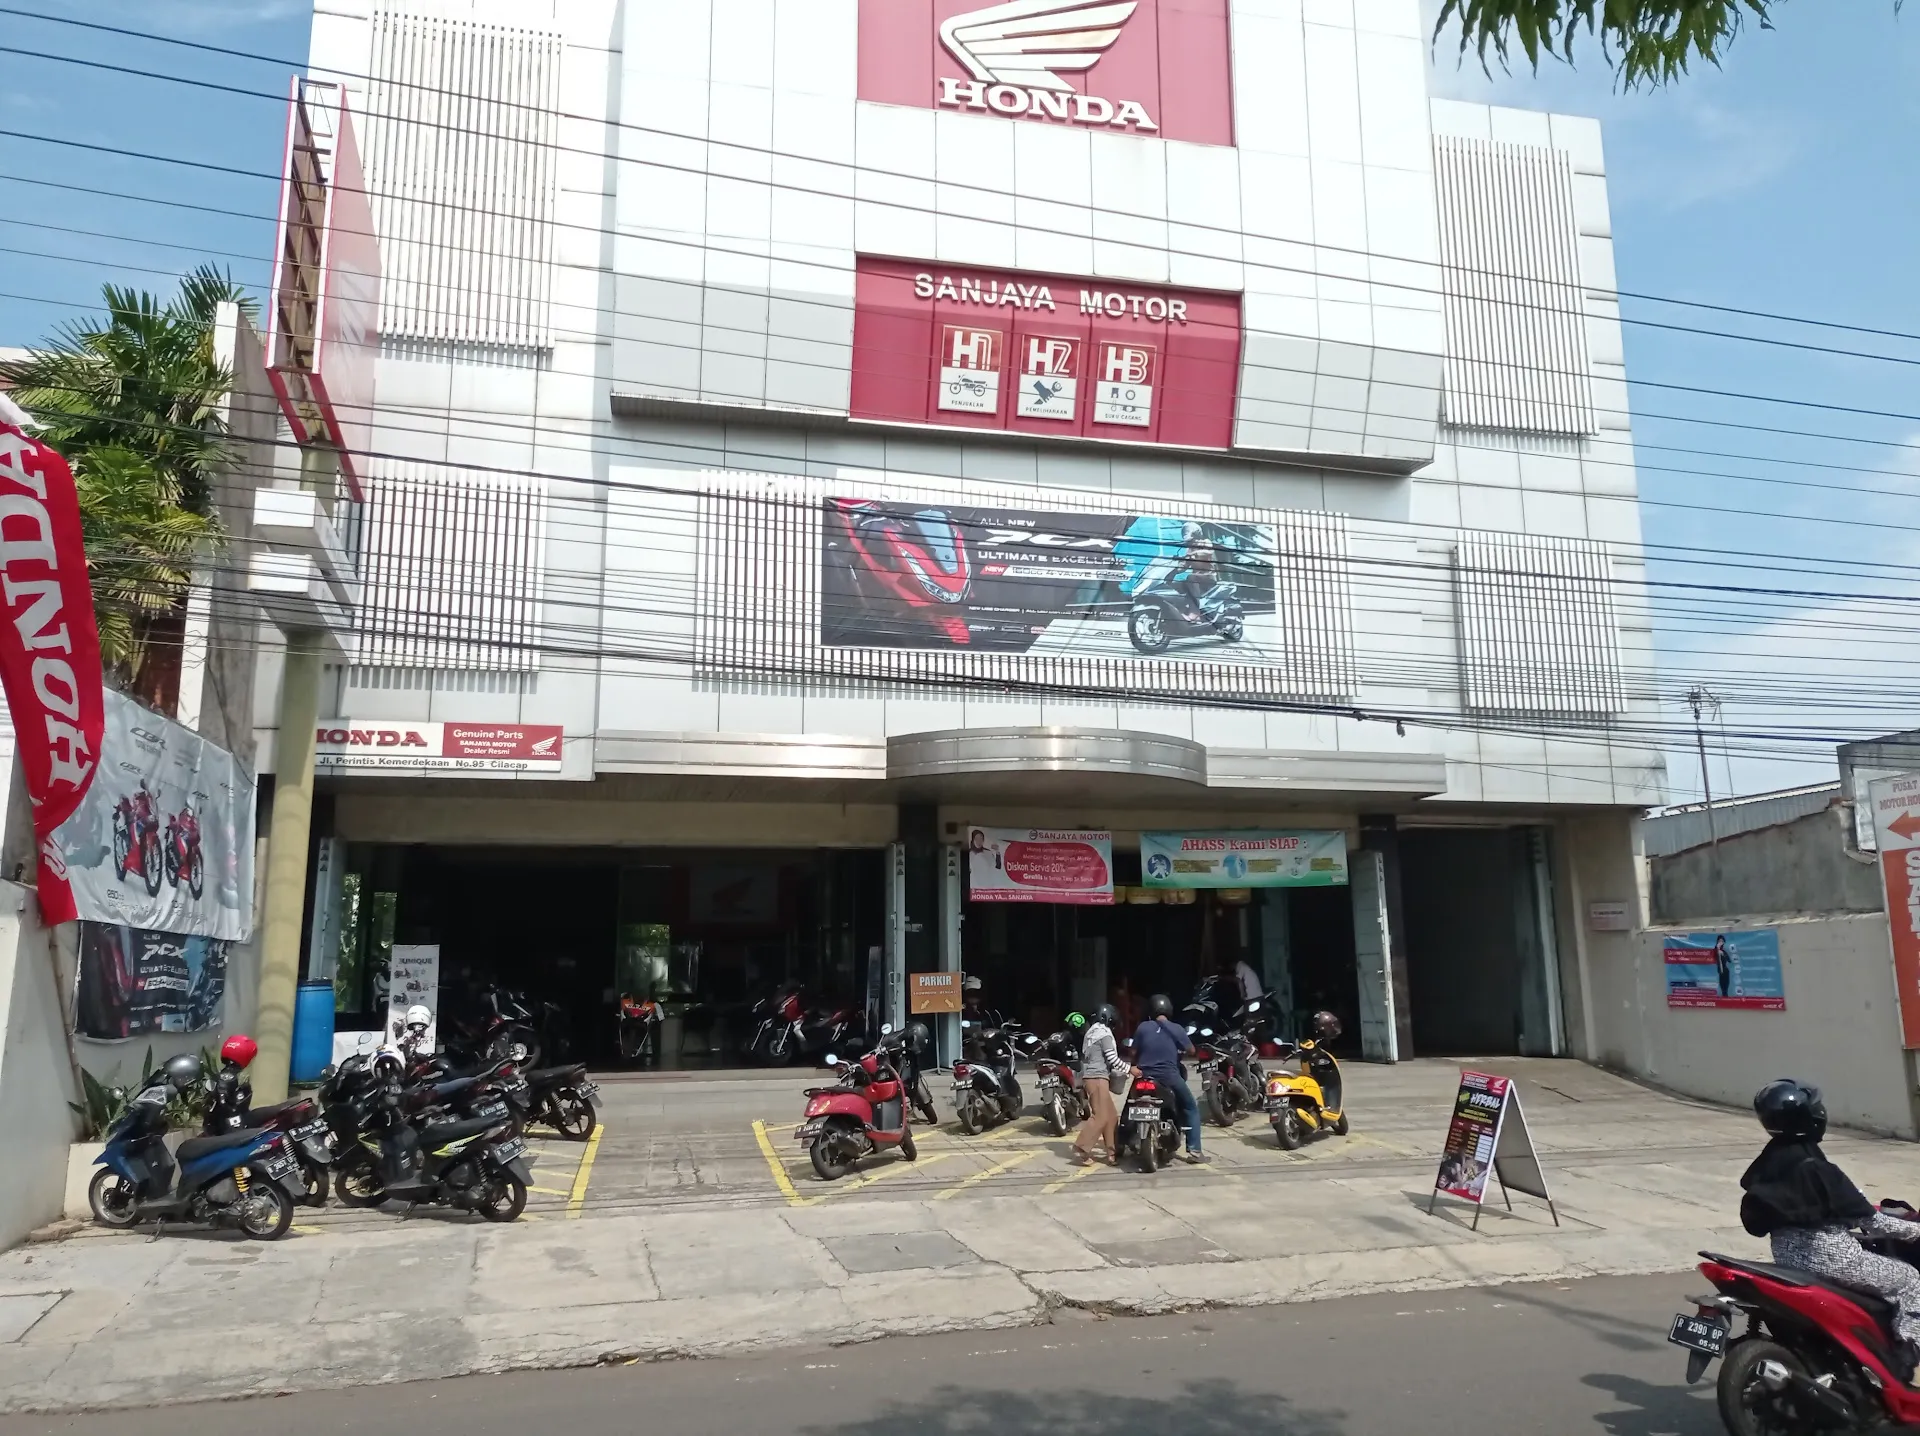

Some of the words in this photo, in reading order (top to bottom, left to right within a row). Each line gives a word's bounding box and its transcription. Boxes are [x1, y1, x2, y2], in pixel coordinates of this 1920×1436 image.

[939, 77, 1159, 131] HONDA
[915, 274, 1056, 311] SANJAYA
[1080, 290, 1187, 324] MOTOR
[952, 330, 992, 370] H1
[1106, 346, 1148, 384] H3
[980, 518, 1004, 526] ALL
[1008, 519, 1036, 527] NEW
[978, 551, 1048, 562] ULTIMATE
[1052, 556, 1135, 565] EXCELLENCE
[453, 729, 495, 739] Genuine
[497, 730, 524, 740] Parts
[336, 757, 375, 765] Perintis
[378, 758, 450, 767] Kemerdekaan
[455, 760, 485, 768] No.95
[490, 760, 528, 769] Cilacap
[1892, 780, 1918, 793] PUSAT
[1039, 832, 1077, 841] SANJAYA
[1079, 833, 1111, 841] MOTOR
[1181, 839, 1225, 851] AHASS
[1229, 838, 1265, 850] Kami
[1269, 837, 1299, 850] SIAP
[1007, 861, 1029, 871] Diskon
[1051, 863, 1066, 873] 20%
[919, 975, 952, 987] PARKIR
[1677, 1317, 1685, 1328] R
[1687, 1321, 1708, 1336] 2390
